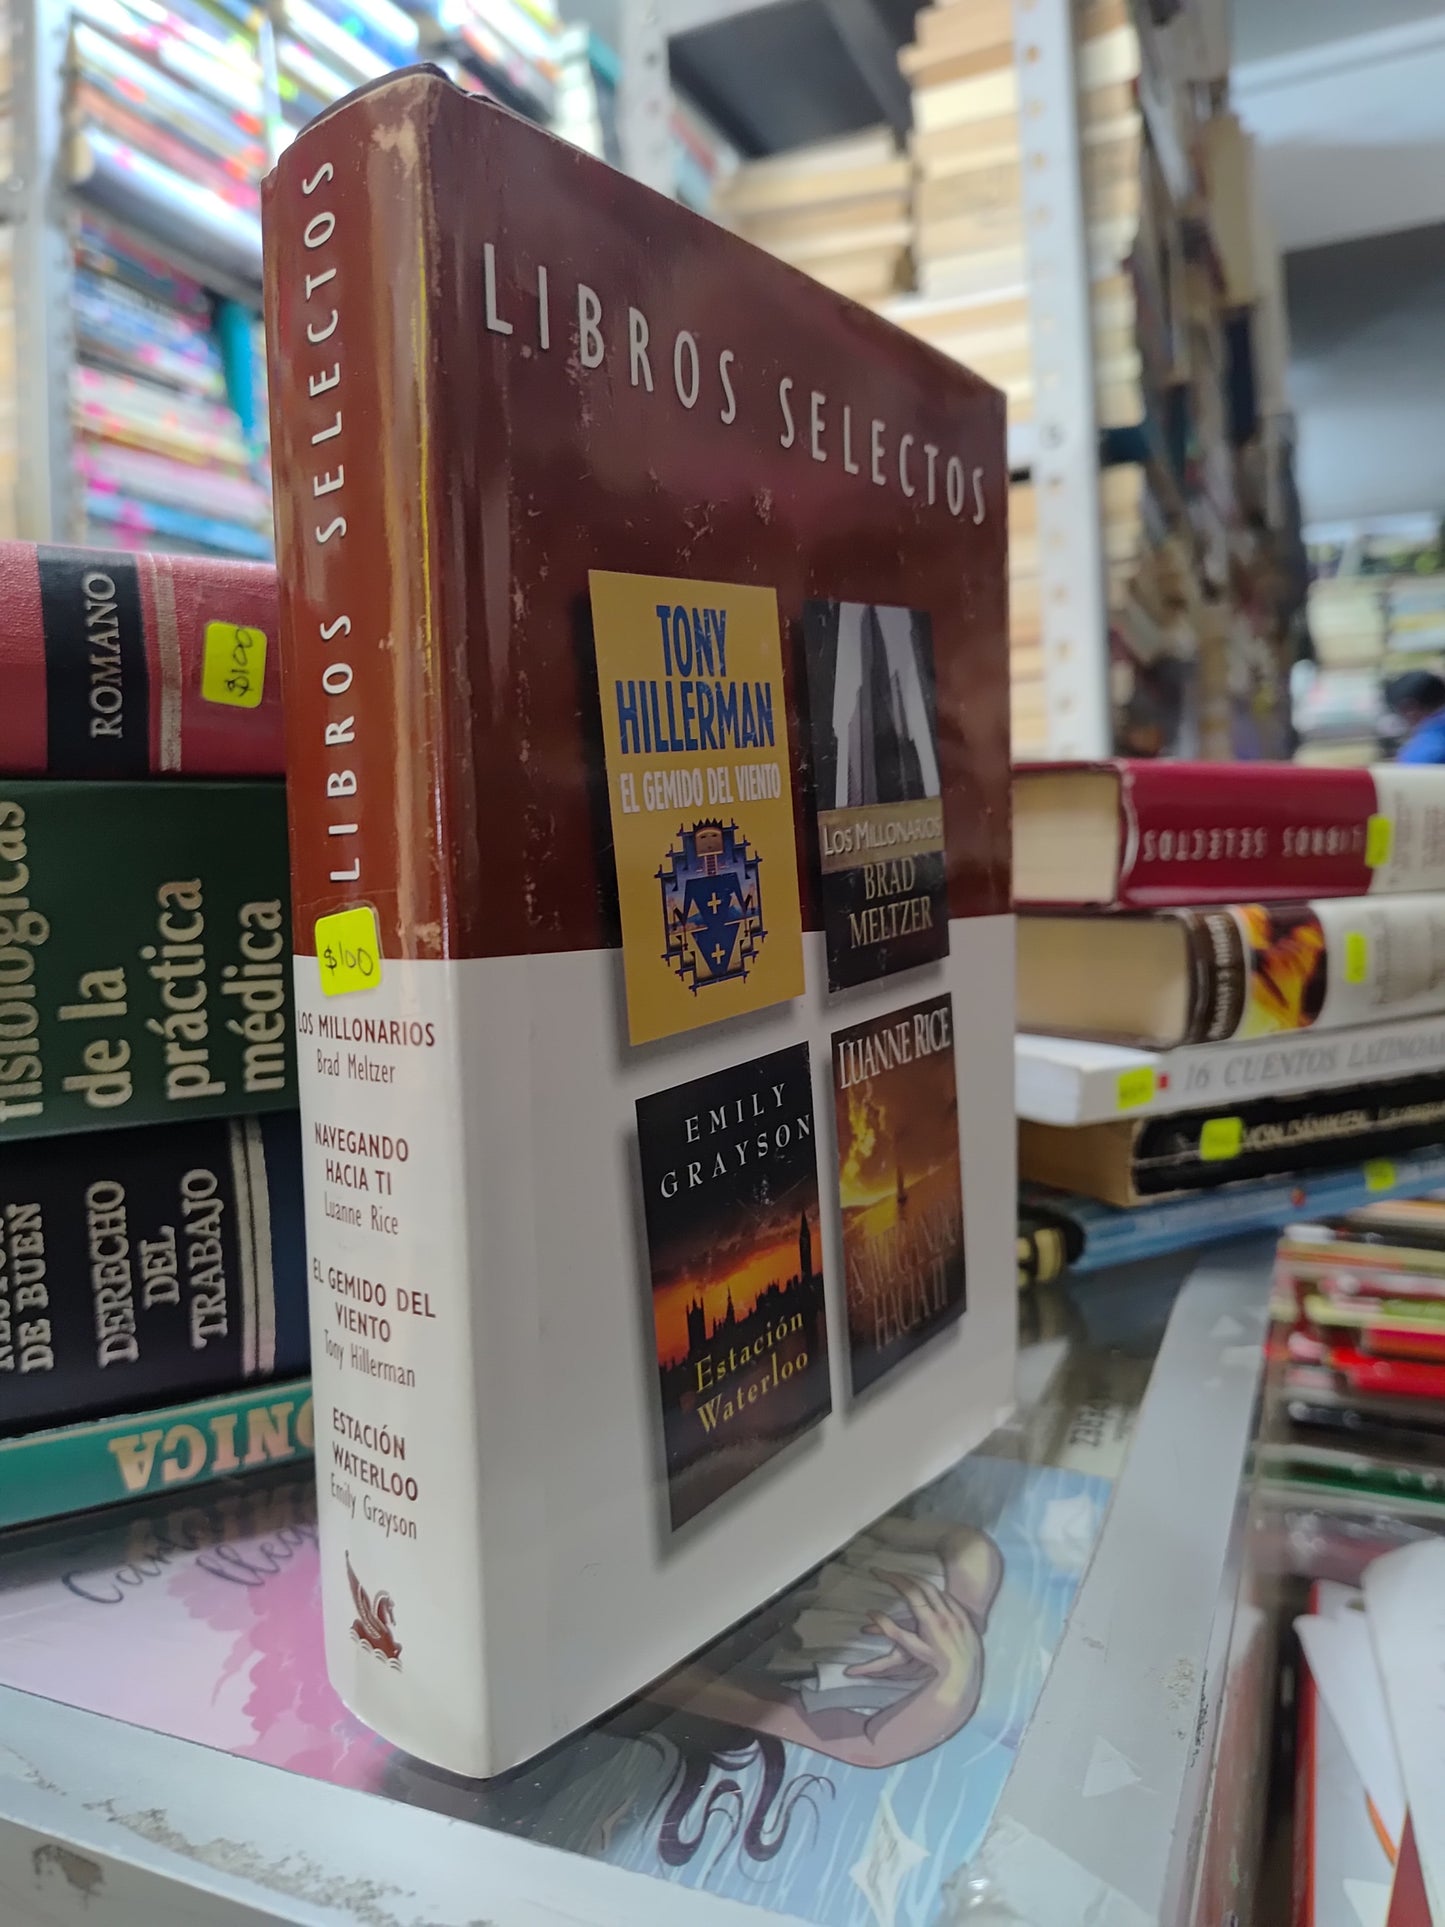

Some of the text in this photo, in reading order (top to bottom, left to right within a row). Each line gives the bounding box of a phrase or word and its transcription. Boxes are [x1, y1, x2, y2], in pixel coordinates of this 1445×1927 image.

[484, 242, 985, 525] LIBROS SELECTOS
[302, 161, 361, 882] LIBROS SELECTOS
[82, 570, 124, 739] ROMANO
[225, 627, 253, 698] $100
[656, 604, 727, 678] TONY
[615, 680, 775, 755] HILLERMAN
[619, 762, 781, 815] EL GEMIDO DEL VIENTO
[863, 856, 916, 901] BRAD
[849, 895, 933, 949] MELTZER
[139, 877, 226, 1100] práctica
[323, 940, 374, 978] $100
[220, 898, 286, 1093] médica
[298, 1010, 436, 1047] LOS MILLONARIOS
[57, 966, 133, 1109] de la
[316, 1048, 396, 1084] Brad Meltzer
[838, 1007, 951, 1090] LUANNE RICE
[314, 1121, 409, 1163] NAVEGANDO
[684, 1083, 785, 1144] EMILY
[325, 1158, 392, 1196] HACIA TI
[660, 1113, 811, 1199] GRAYSON
[324, 1191, 399, 1236] Luanne Rice
[6, 1202, 54, 1374] DE BUEN
[85, 1179, 139, 1369] DERECHO
[138, 1225, 180, 1311] DEL
[180, 1168, 229, 1350] TRABAJO
[313, 1256, 437, 1319] EL GEMIDO DEL
[335, 1302, 392, 1343] VIENTO
[694, 1312, 803, 1394] Estación
[324, 1329, 416, 1388] Tony Hillerman
[696, 1352, 808, 1434] Waterloo
[332, 1406, 406, 1461] ESTACIÓN
[330, 1472, 417, 1540] Emily Grayson
[332, 1441, 419, 1502] WATERLOO
